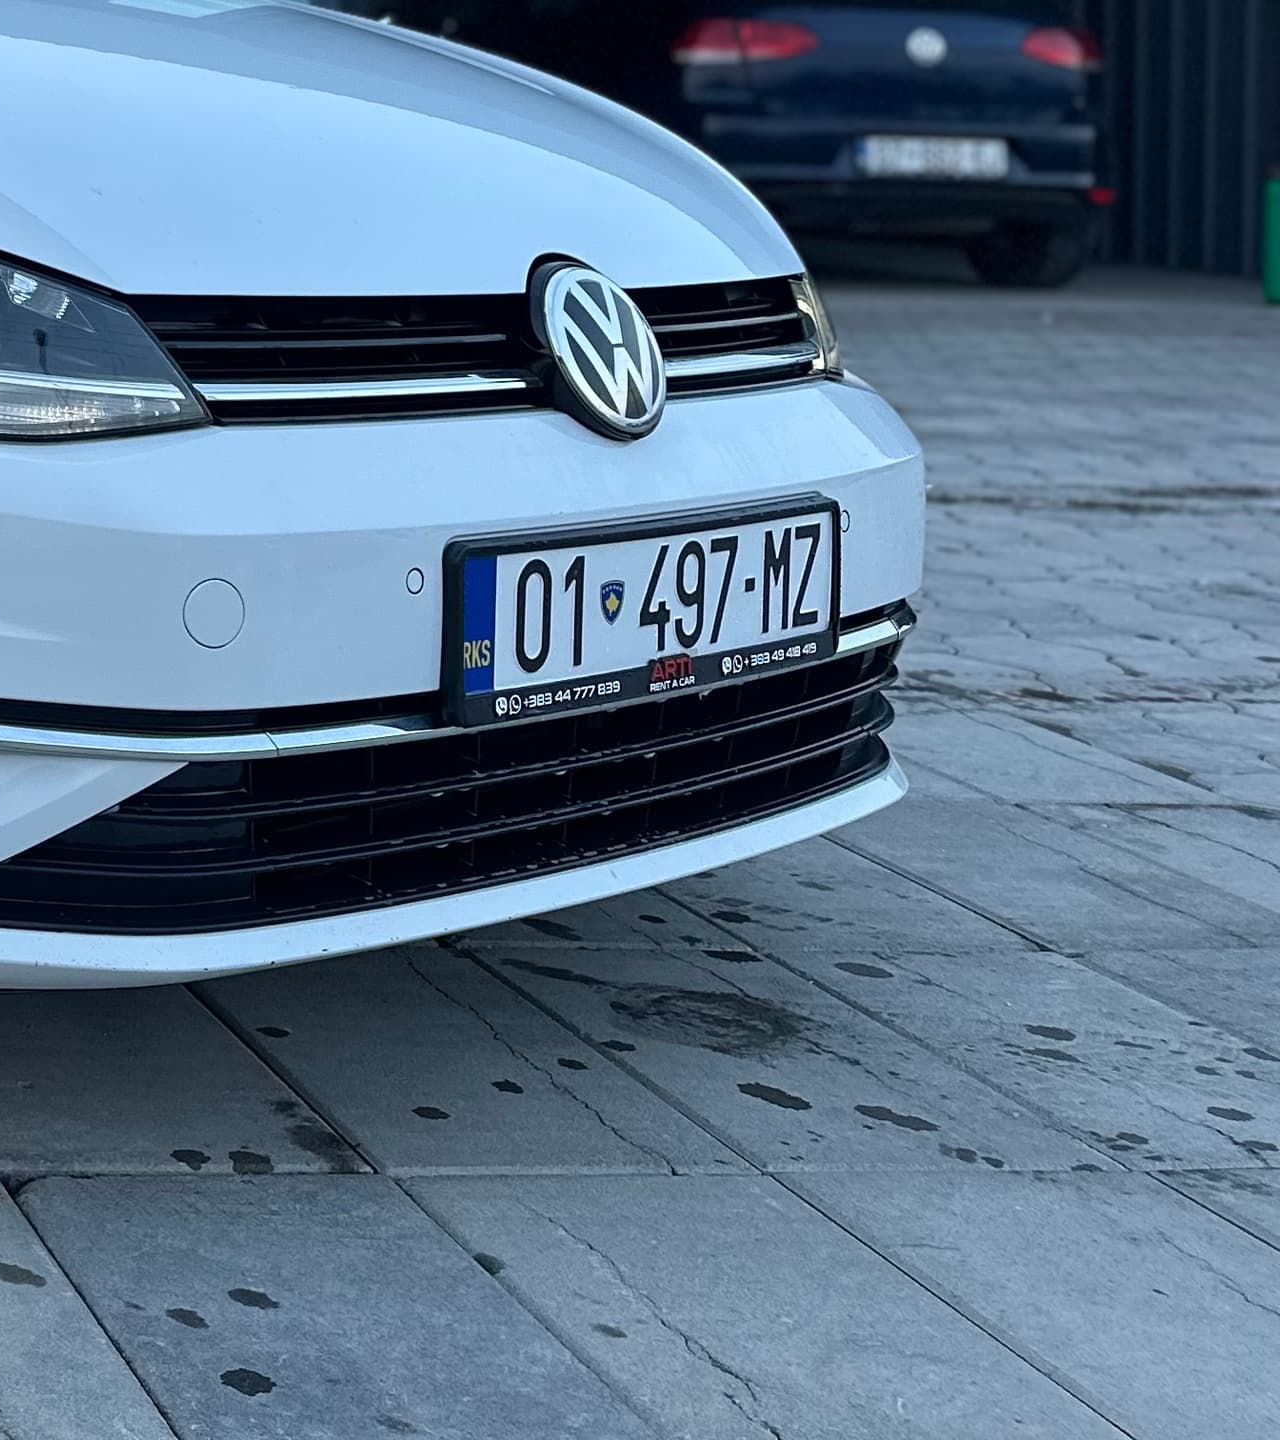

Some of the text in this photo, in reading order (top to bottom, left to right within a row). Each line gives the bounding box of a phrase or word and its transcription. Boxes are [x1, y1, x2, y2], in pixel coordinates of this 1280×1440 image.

[515, 555, 586, 673] 01
[463, 639, 491, 669] RKS
[771, 649, 785, 662] 49
[651, 655, 694, 682] ARTI
[523, 680, 621, 709] +383 44 777 839
[649, 675, 696, 693] RENT A CAR
